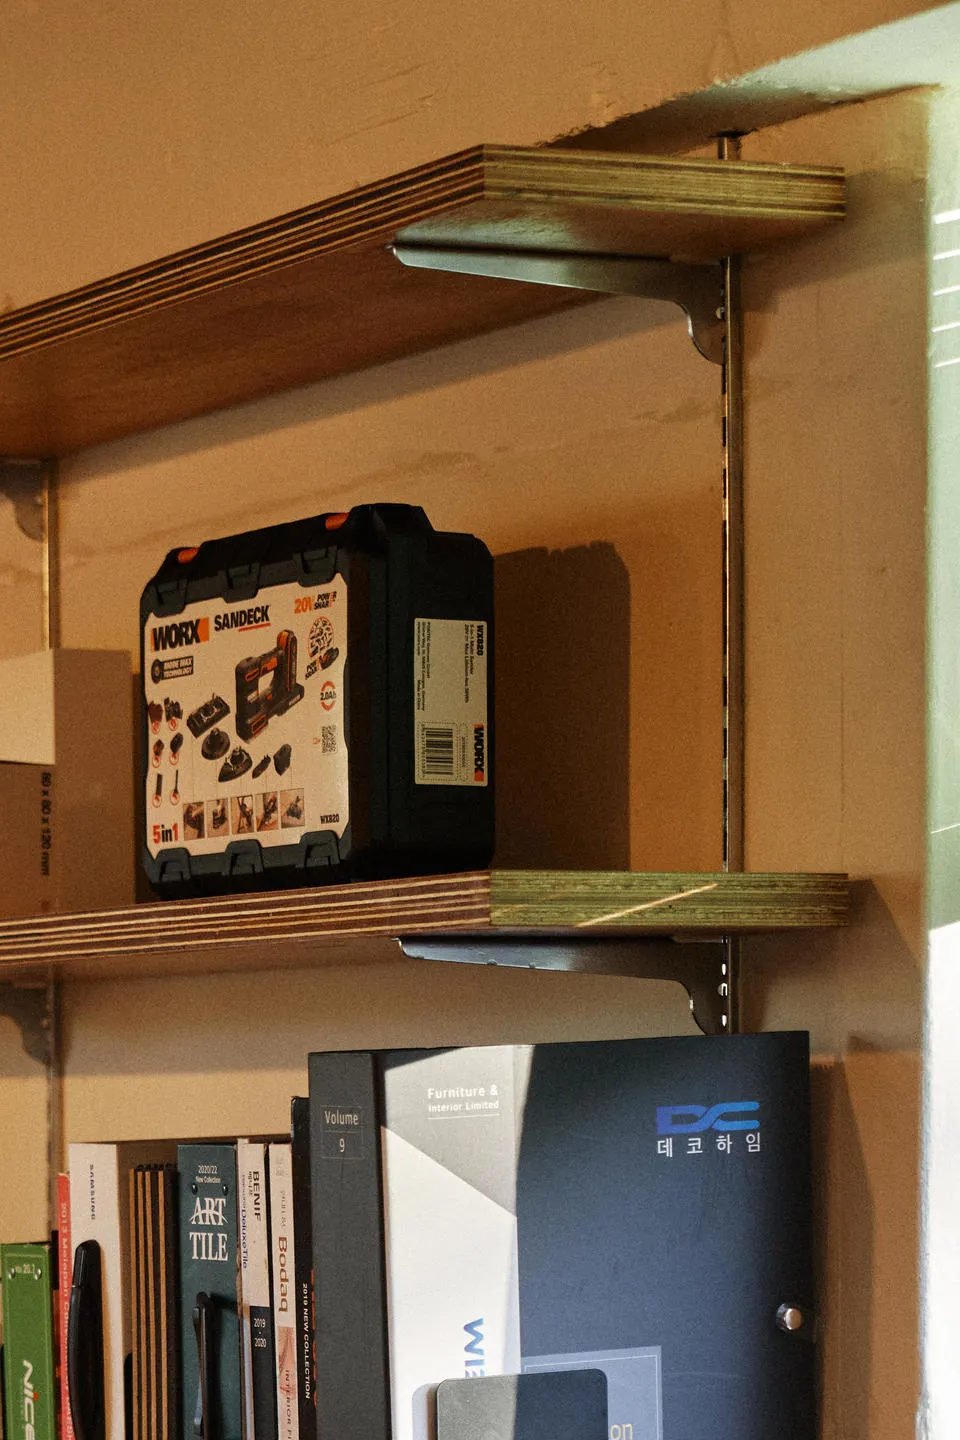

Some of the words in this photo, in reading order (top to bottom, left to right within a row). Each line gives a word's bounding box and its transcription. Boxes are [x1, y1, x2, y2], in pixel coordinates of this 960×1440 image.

[214, 605, 271, 632] SANDECK
[152, 618, 201, 651] WORX
[474, 727, 484, 773] WORX
[427, 1087, 486, 1100] Furniture
[489, 1084, 499, 1097] &
[428, 1103, 463, 1113] Interior
[465, 1100, 500, 1111] Limited
[324, 1108, 359, 1125] Volume
[338, 1137, 345, 1153] 9
[656, 1131, 762, 1158] 데코하임
[190, 1196, 227, 1226] ART
[253, 1170, 262, 1222] BENIF
[189, 1231, 229, 1261] TILE
[278, 1236, 289, 1313] Bodaq
[303, 1334, 311, 1399] COLLECTION
